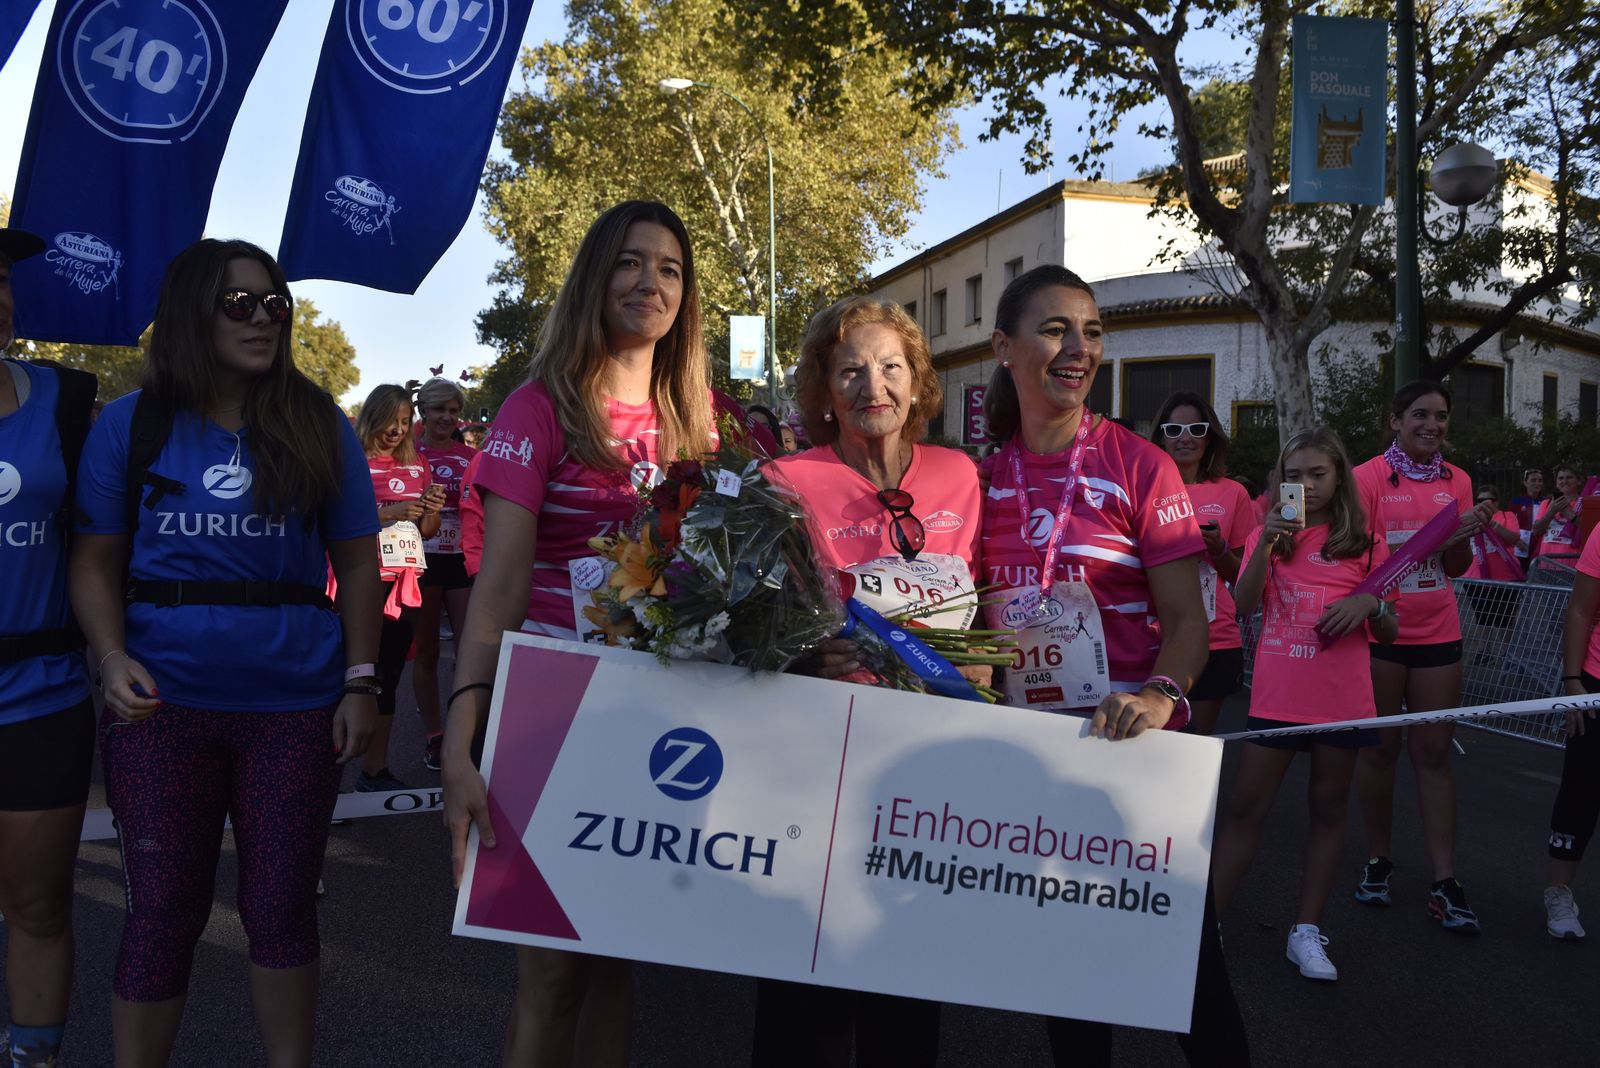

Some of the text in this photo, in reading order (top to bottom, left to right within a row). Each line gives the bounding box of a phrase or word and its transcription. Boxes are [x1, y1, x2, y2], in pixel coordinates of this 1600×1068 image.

[90, 25, 204, 94] 40'
[1310, 71, 1339, 82] DON
[1310, 83, 1372, 97] PASQUALE
[325, 190, 370, 216] Carrera
[339, 179, 383, 204] ASTURIANA
[342, 212, 380, 236] Mujer
[59, 236, 109, 259] ASTURIANA
[45, 249, 96, 274] Carrera
[68, 270, 108, 295] Mujer
[494, 429, 504, 439] de
[505, 430, 514, 441] la
[1152, 491, 1188, 508] Carrera
[1381, 495, 1412, 503] OYSHO
[156, 512, 286, 537] ZURICH
[827, 524, 882, 540] OYSHO
[924, 520, 961, 529] ASTURIANA
[399, 539, 417, 550] 016
[905, 642, 943, 677] ZURICH
[1289, 644, 1316, 659] 2019
[1024, 672, 1052, 685] 4049
[568, 811, 779, 877] ZURICH
[872, 798, 1172, 874] ¡Enhorabuena!
[865, 846, 1171, 916] #MujerImparable
